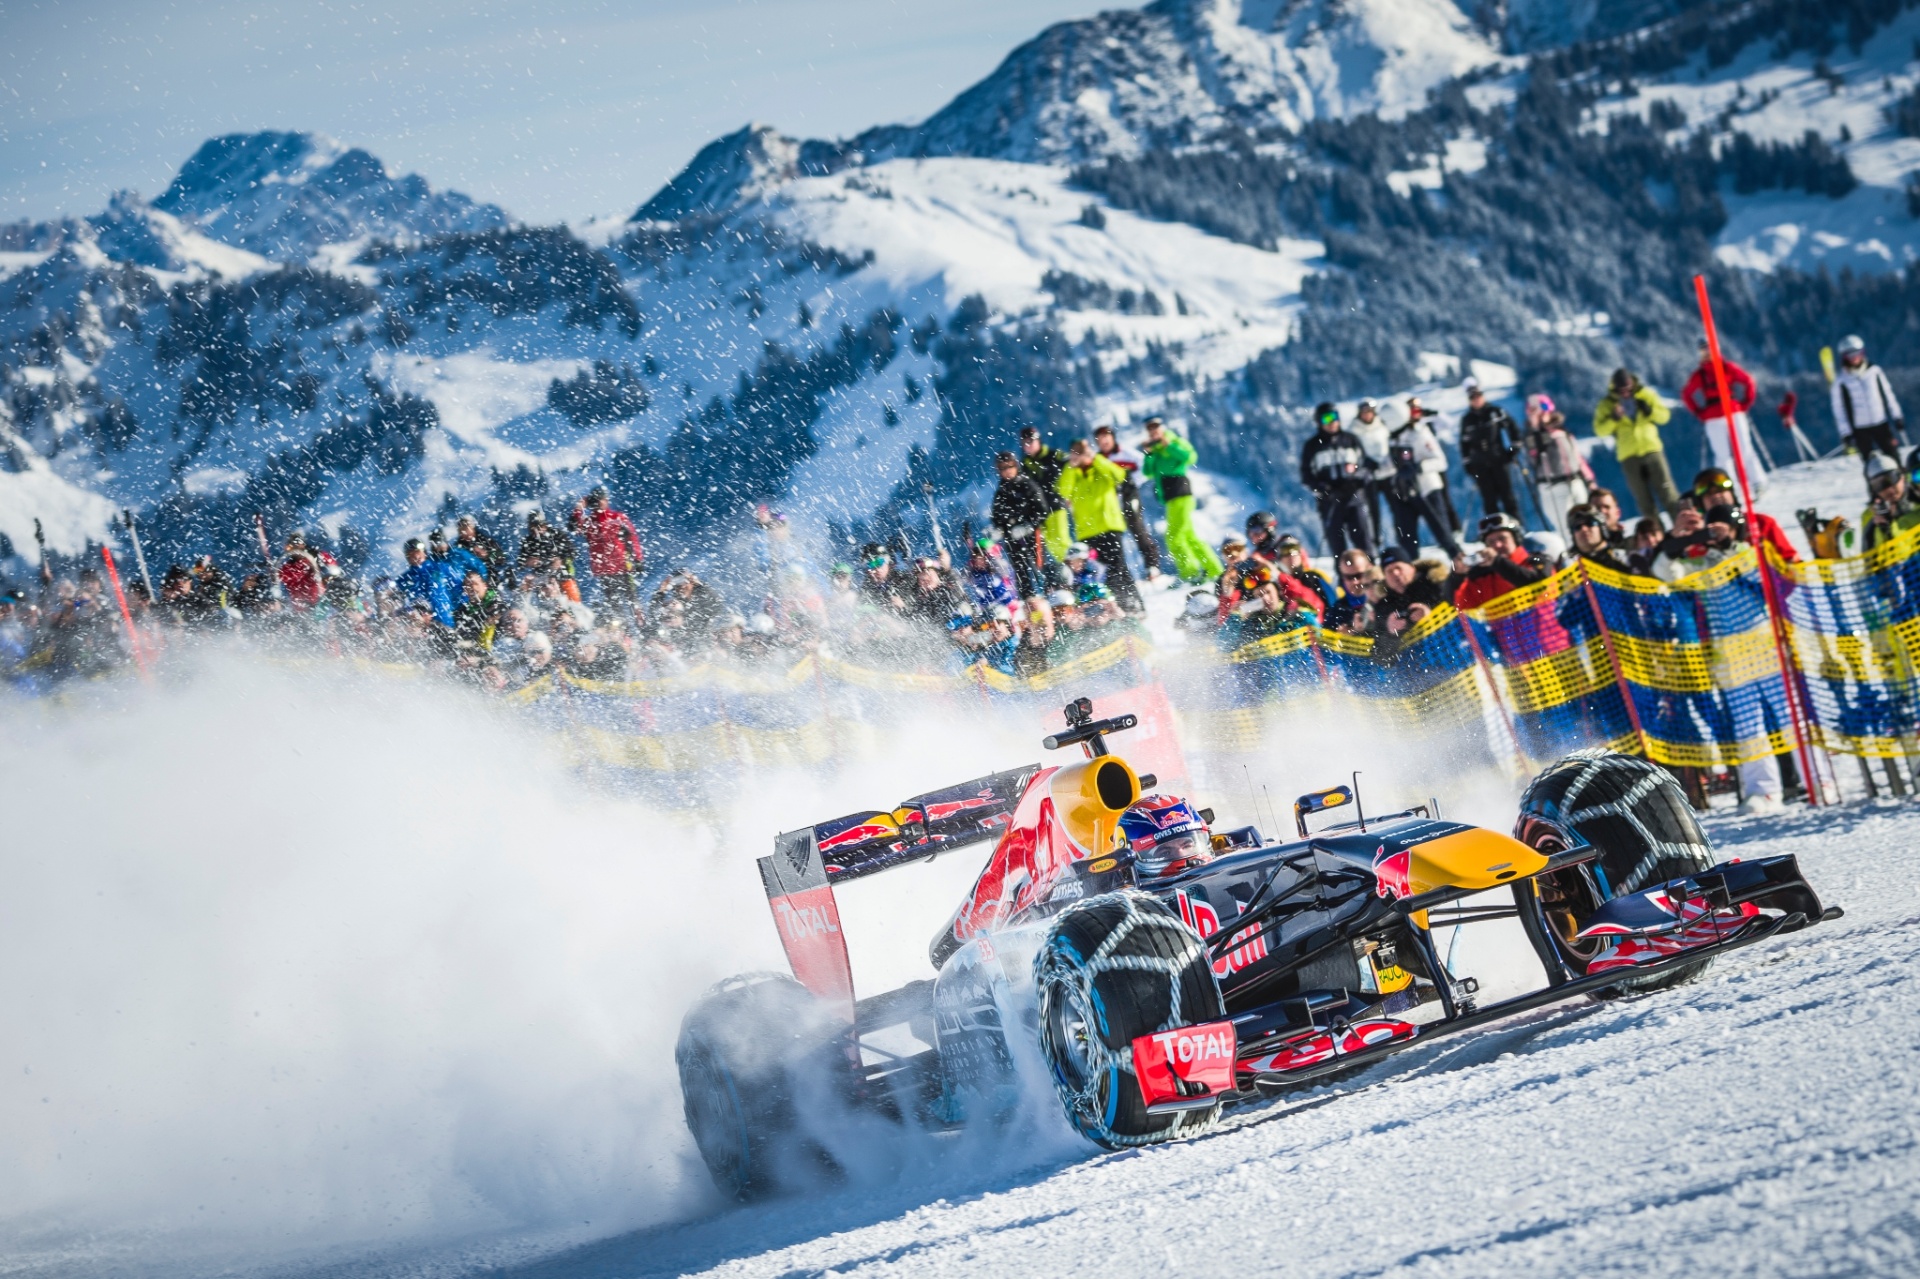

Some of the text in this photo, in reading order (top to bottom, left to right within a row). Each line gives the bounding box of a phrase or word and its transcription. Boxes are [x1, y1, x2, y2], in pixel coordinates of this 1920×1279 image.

[1153, 829, 1172, 840] GIVES
[1172, 824, 1186, 834] YOU
[1095, 861, 1114, 870] RAUCH
[777, 904, 838, 940] TOTAL
[978, 939, 995, 962] 33
[1152, 1031, 1232, 1065] TOTAL
